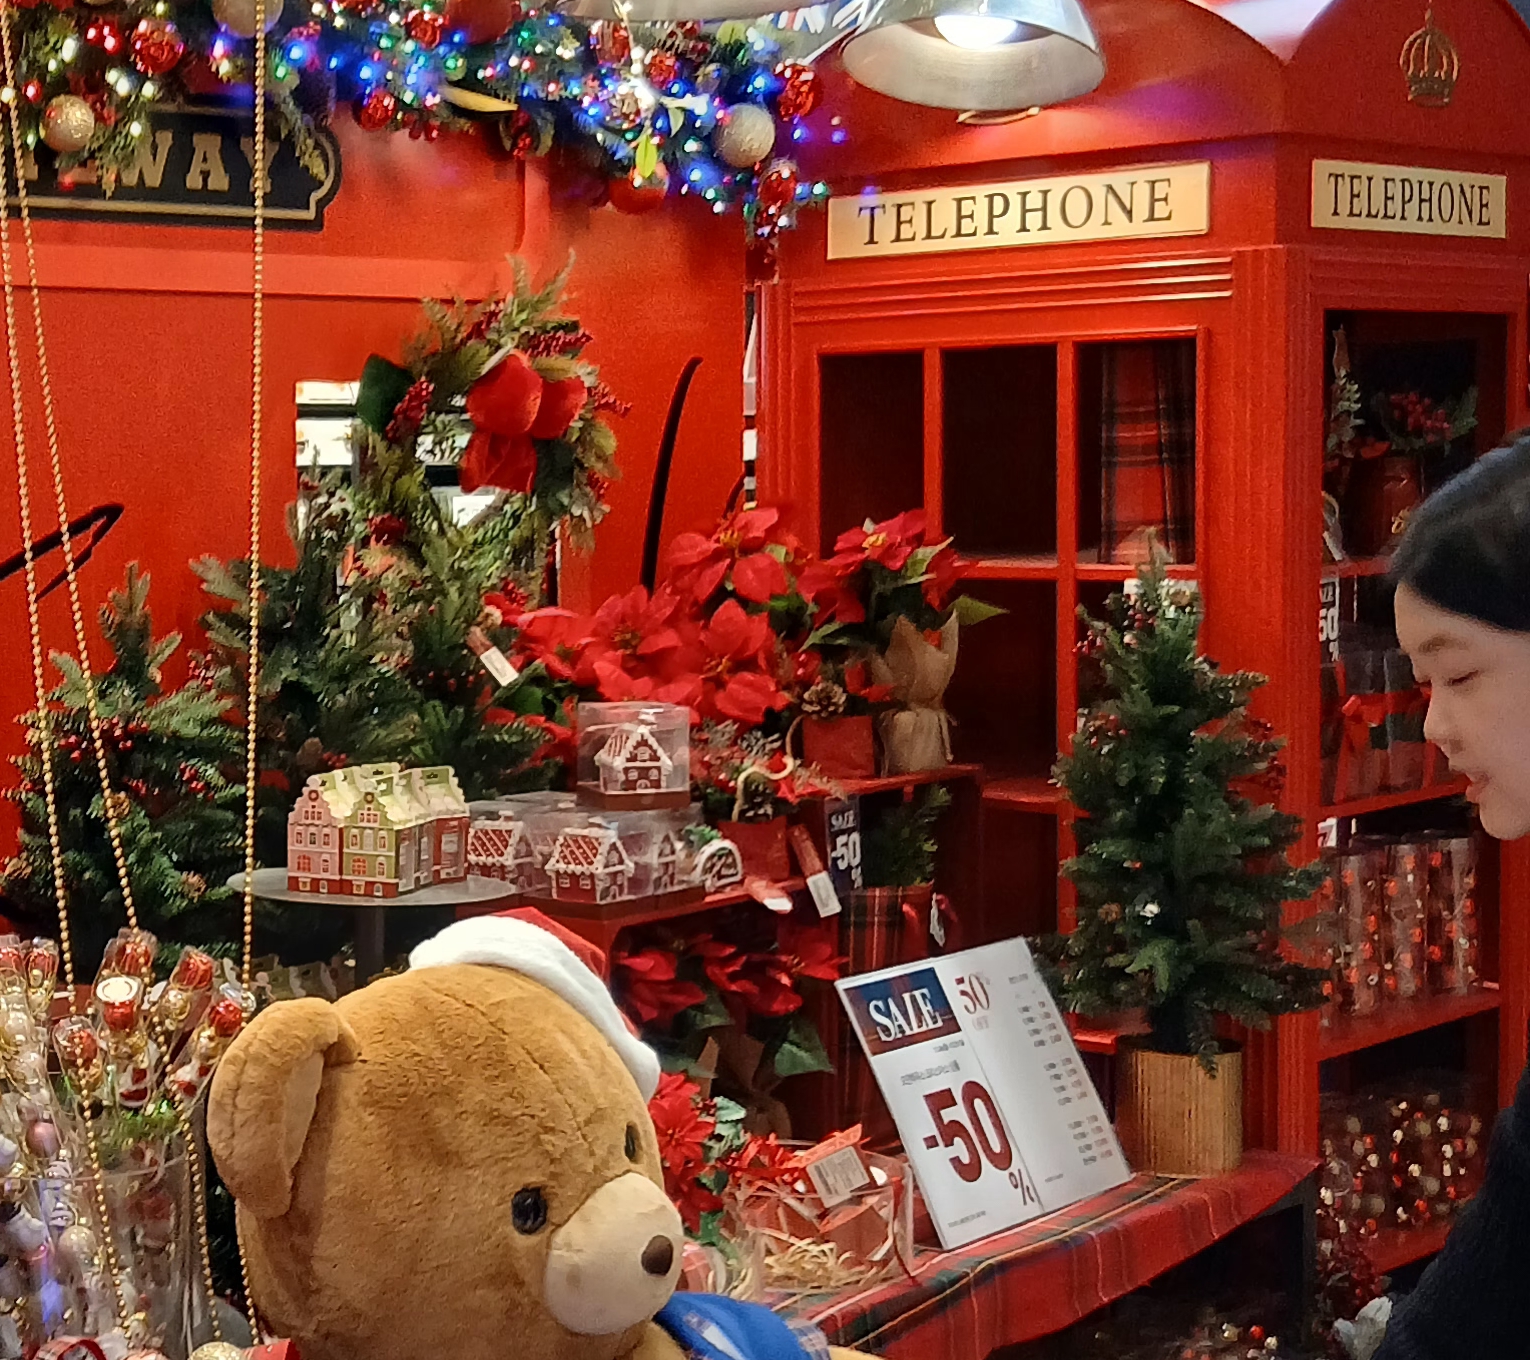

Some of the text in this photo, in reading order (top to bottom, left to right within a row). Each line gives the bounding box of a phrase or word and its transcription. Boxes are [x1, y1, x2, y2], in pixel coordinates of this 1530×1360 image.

[858, 178, 1174, 246] TELEPHONE
[1327, 171, 1492, 227] TELEPHONE
[869, 987, 944, 1042] SALE
